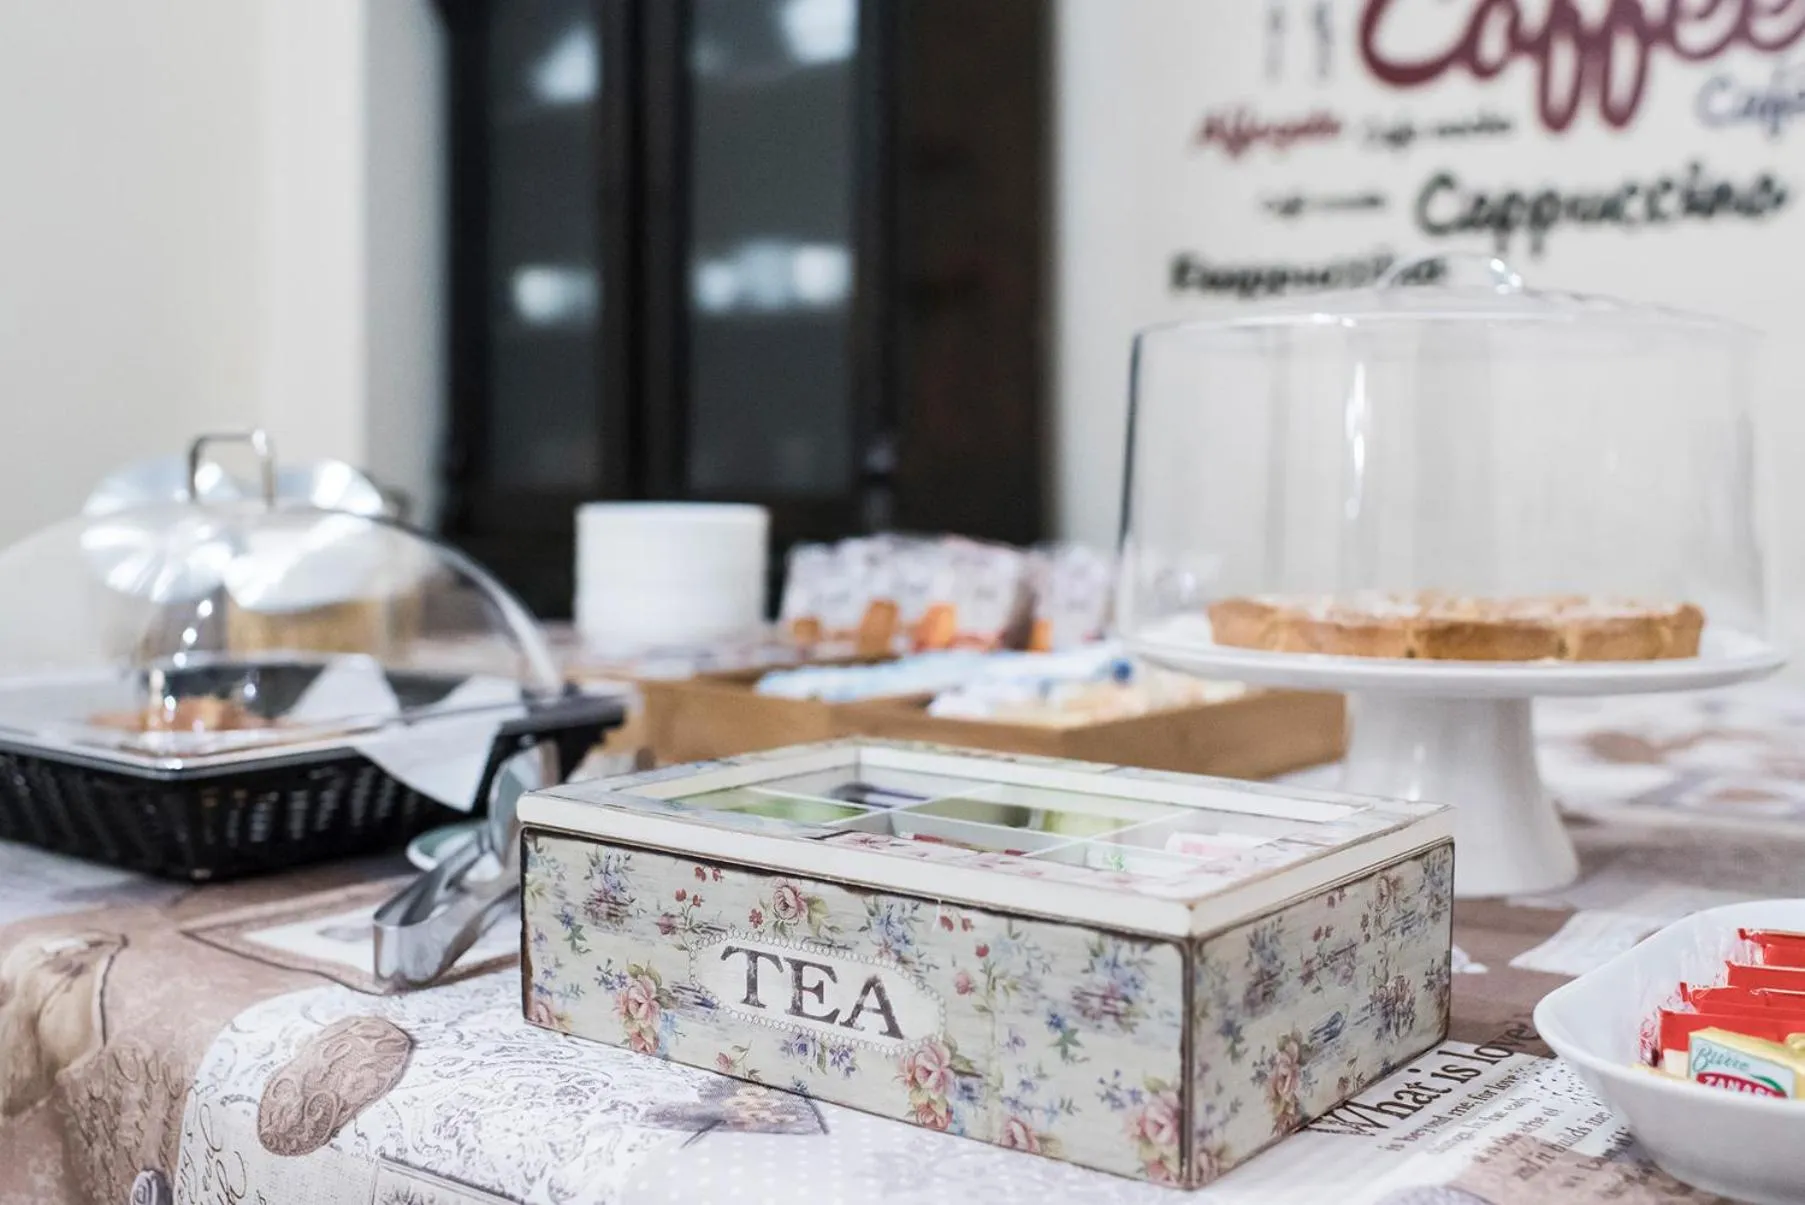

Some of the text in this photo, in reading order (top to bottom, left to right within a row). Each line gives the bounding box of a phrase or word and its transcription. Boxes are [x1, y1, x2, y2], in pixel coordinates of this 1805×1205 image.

[1416, 163, 1787, 255] Cappuccino
[720, 945, 905, 1040] TEA
[1407, 1064, 1482, 1084] is
